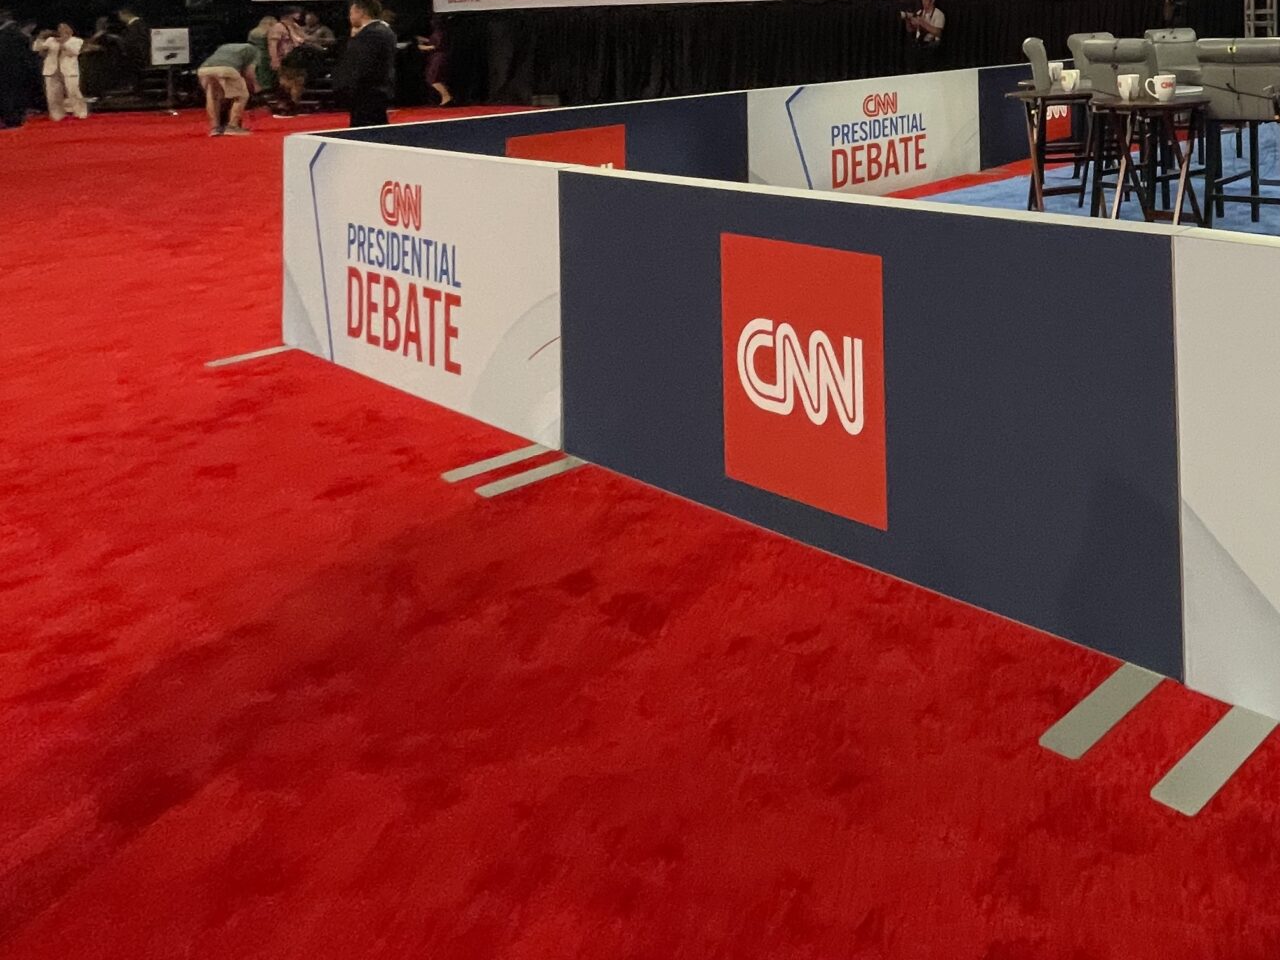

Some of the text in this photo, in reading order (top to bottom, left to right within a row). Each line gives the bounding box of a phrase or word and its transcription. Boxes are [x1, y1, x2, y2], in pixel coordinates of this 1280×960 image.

[831, 112, 926, 147] PRESIDENTIAL
[863, 92, 898, 117] CNN
[831, 133, 927, 190] DEBATE
[379, 180, 422, 231] CNN
[347, 222, 462, 289] PRESIDENTIAL
[347, 265, 462, 376] DEBATE
[737, 317, 864, 435] CNN
